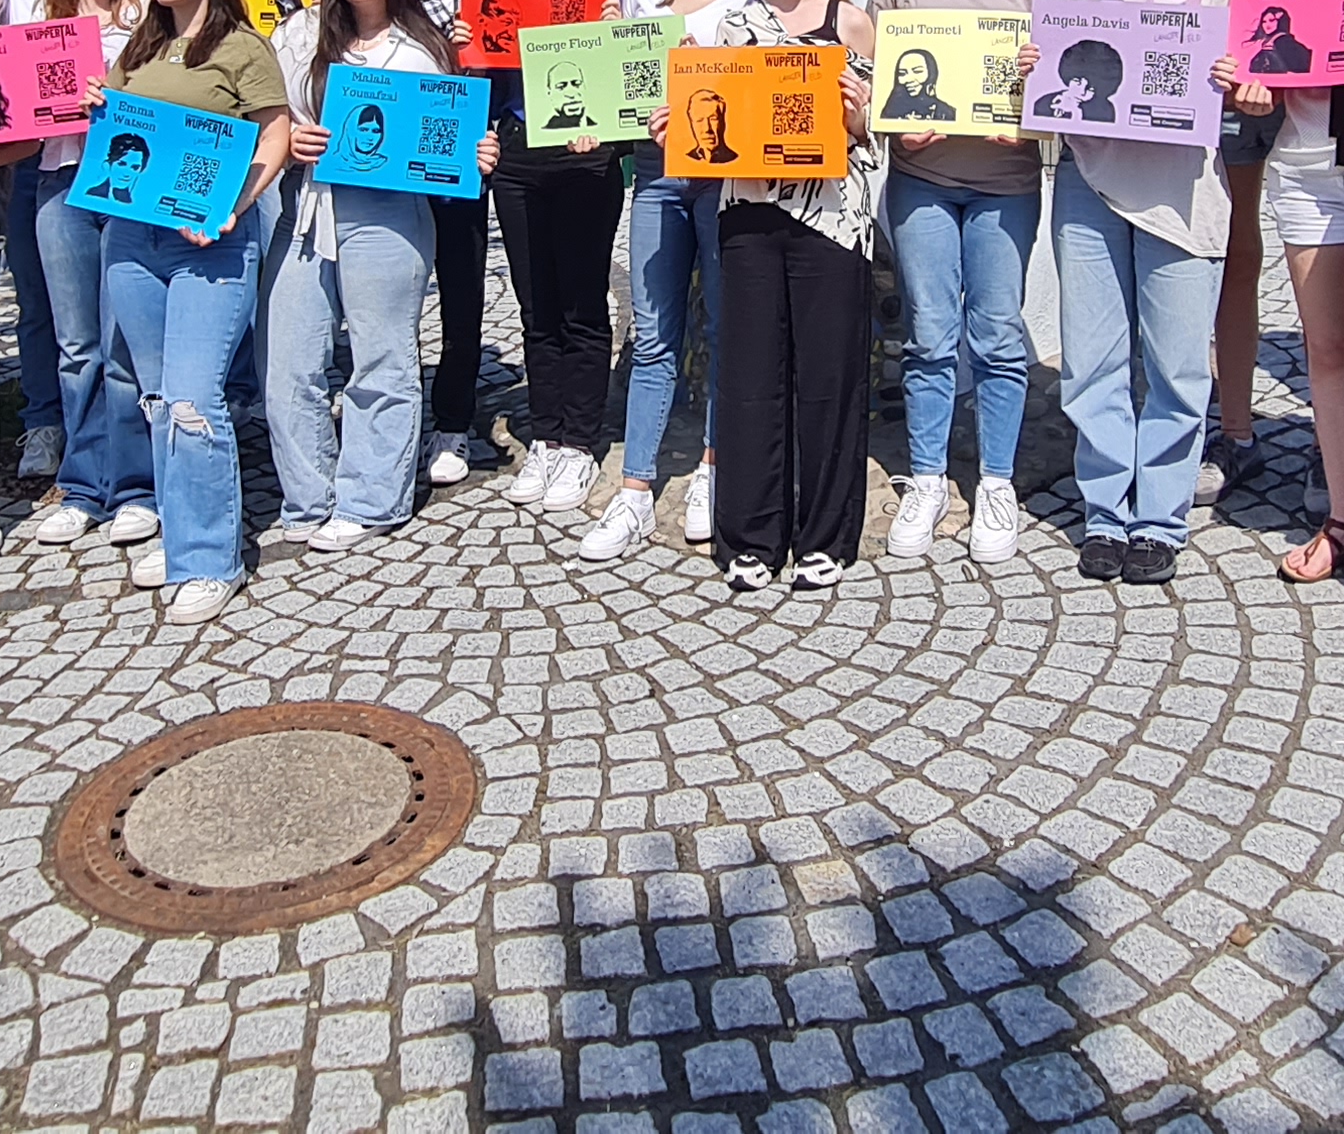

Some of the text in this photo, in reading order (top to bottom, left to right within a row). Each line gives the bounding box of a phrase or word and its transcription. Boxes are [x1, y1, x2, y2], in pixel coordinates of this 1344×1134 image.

[886, 24, 962, 36] Opal Tometi
[1042, 14, 1130, 29] Angela Davis
[1140, 10, 1200, 44] WUPPERTAL
[24, 24, 78, 51] WUPPERTAL
[526, 36, 602, 53] George Floyd
[612, 22, 662, 50] WUPPERTAL
[674, 62, 754, 74] Ian McKellen
[765, 52, 820, 83] WUPPERTAL
[352, 72, 392, 85] Malala
[342, 86, 398, 102] Yousafzai
[420, 79, 468, 109] WUPPERTAL
[118, 101, 155, 118] Emma
[112, 113, 156, 132] Watson
[185, 114, 234, 150] WUPPERTAL
